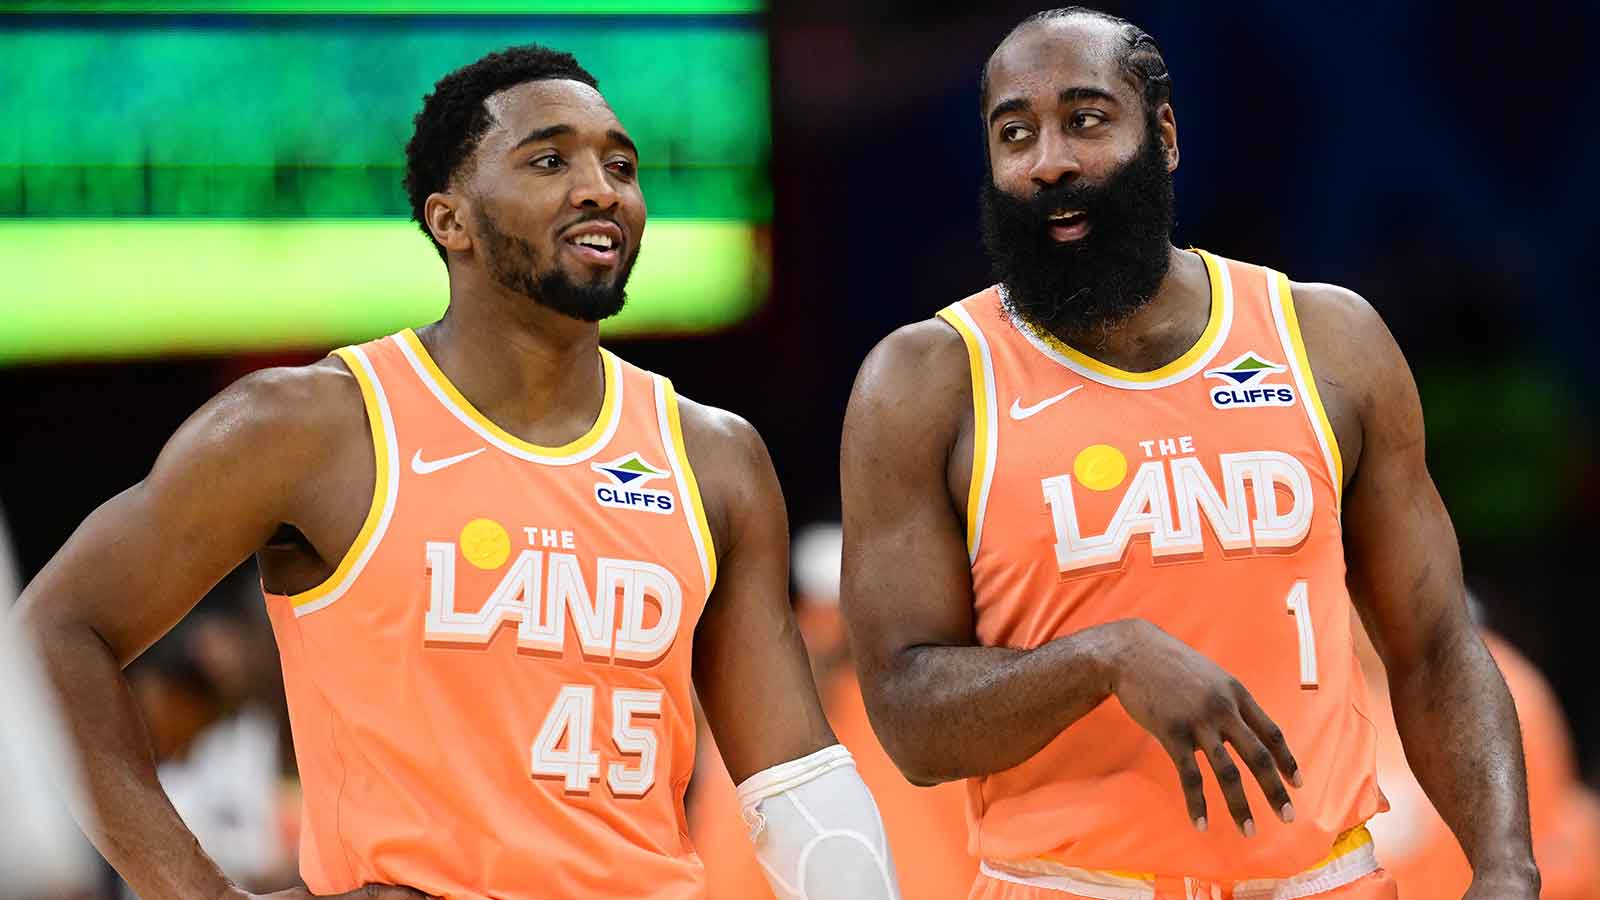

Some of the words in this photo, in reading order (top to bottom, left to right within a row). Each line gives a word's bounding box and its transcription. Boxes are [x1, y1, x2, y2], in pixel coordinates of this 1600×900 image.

[1214, 388, 1293, 405] CLIFFS
[1139, 436, 1196, 457] THE
[597, 488, 672, 510] CLIFFS
[1041, 451, 1314, 575] LAND
[523, 527, 576, 550] THE
[424, 541, 683, 667] LAND
[1286, 581, 1319, 690] 1
[531, 684, 665, 799] 45
